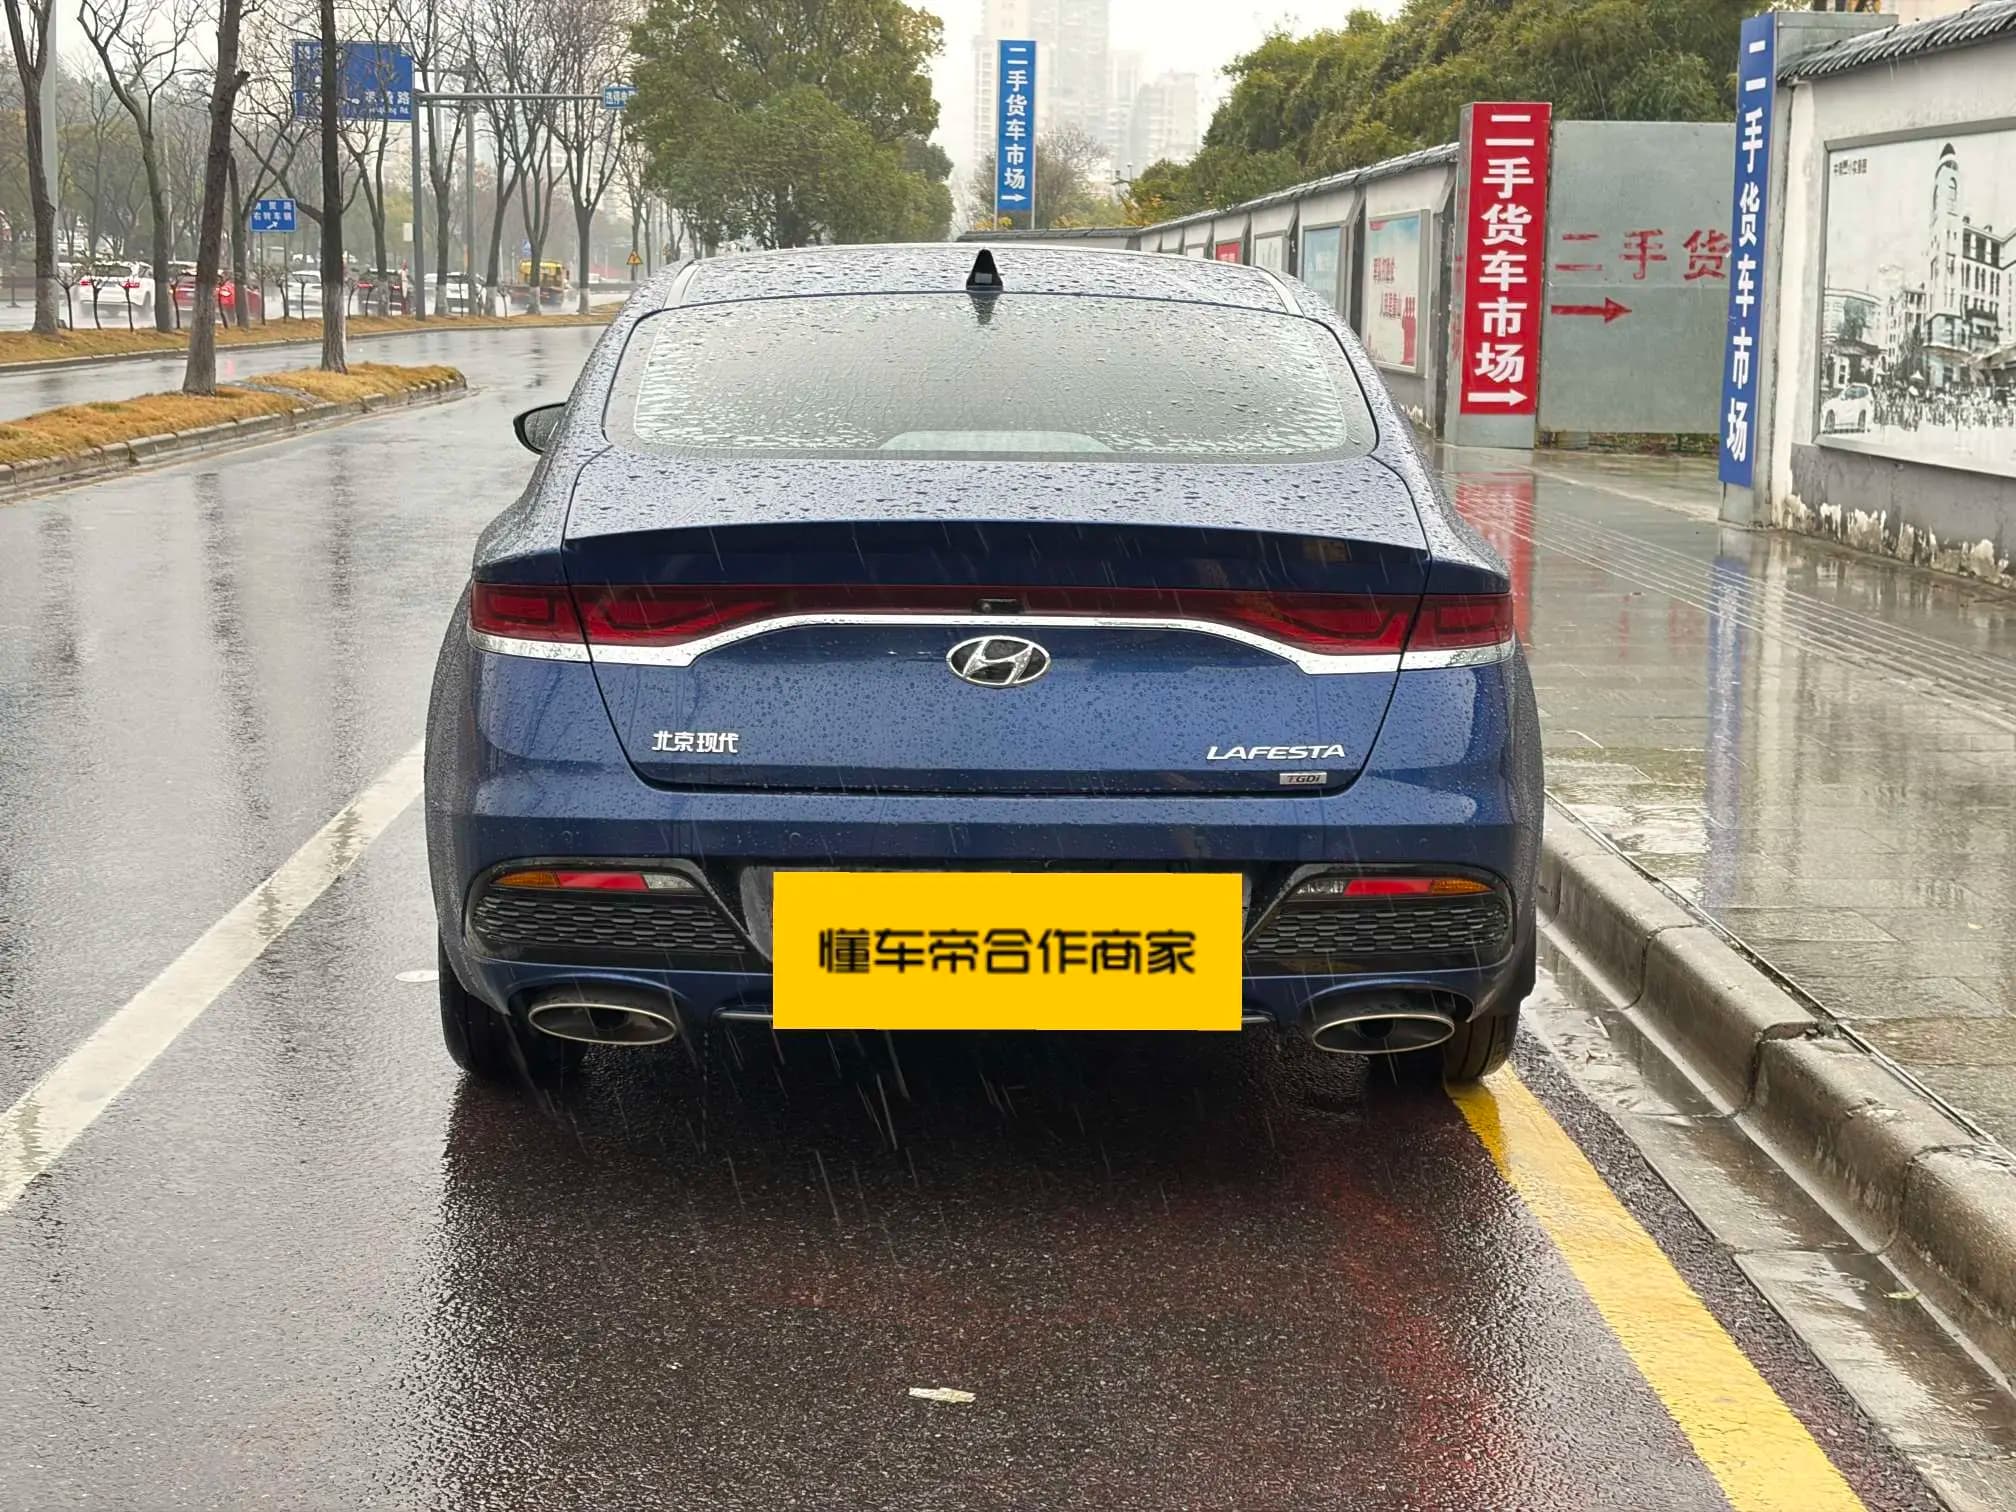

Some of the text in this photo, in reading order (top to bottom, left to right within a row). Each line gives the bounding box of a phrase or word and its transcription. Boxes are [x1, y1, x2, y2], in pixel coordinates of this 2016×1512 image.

[1004, 47, 1029, 190] 二手货车市场
[1474, 114, 1535, 384] 二手货车市场
[1554, 229, 1732, 281] 二手货
[1726, 40, 1767, 463] 二手货车市场
[651, 730, 740, 754] 北京现代
[1206, 744, 1346, 760] LAFESTA
